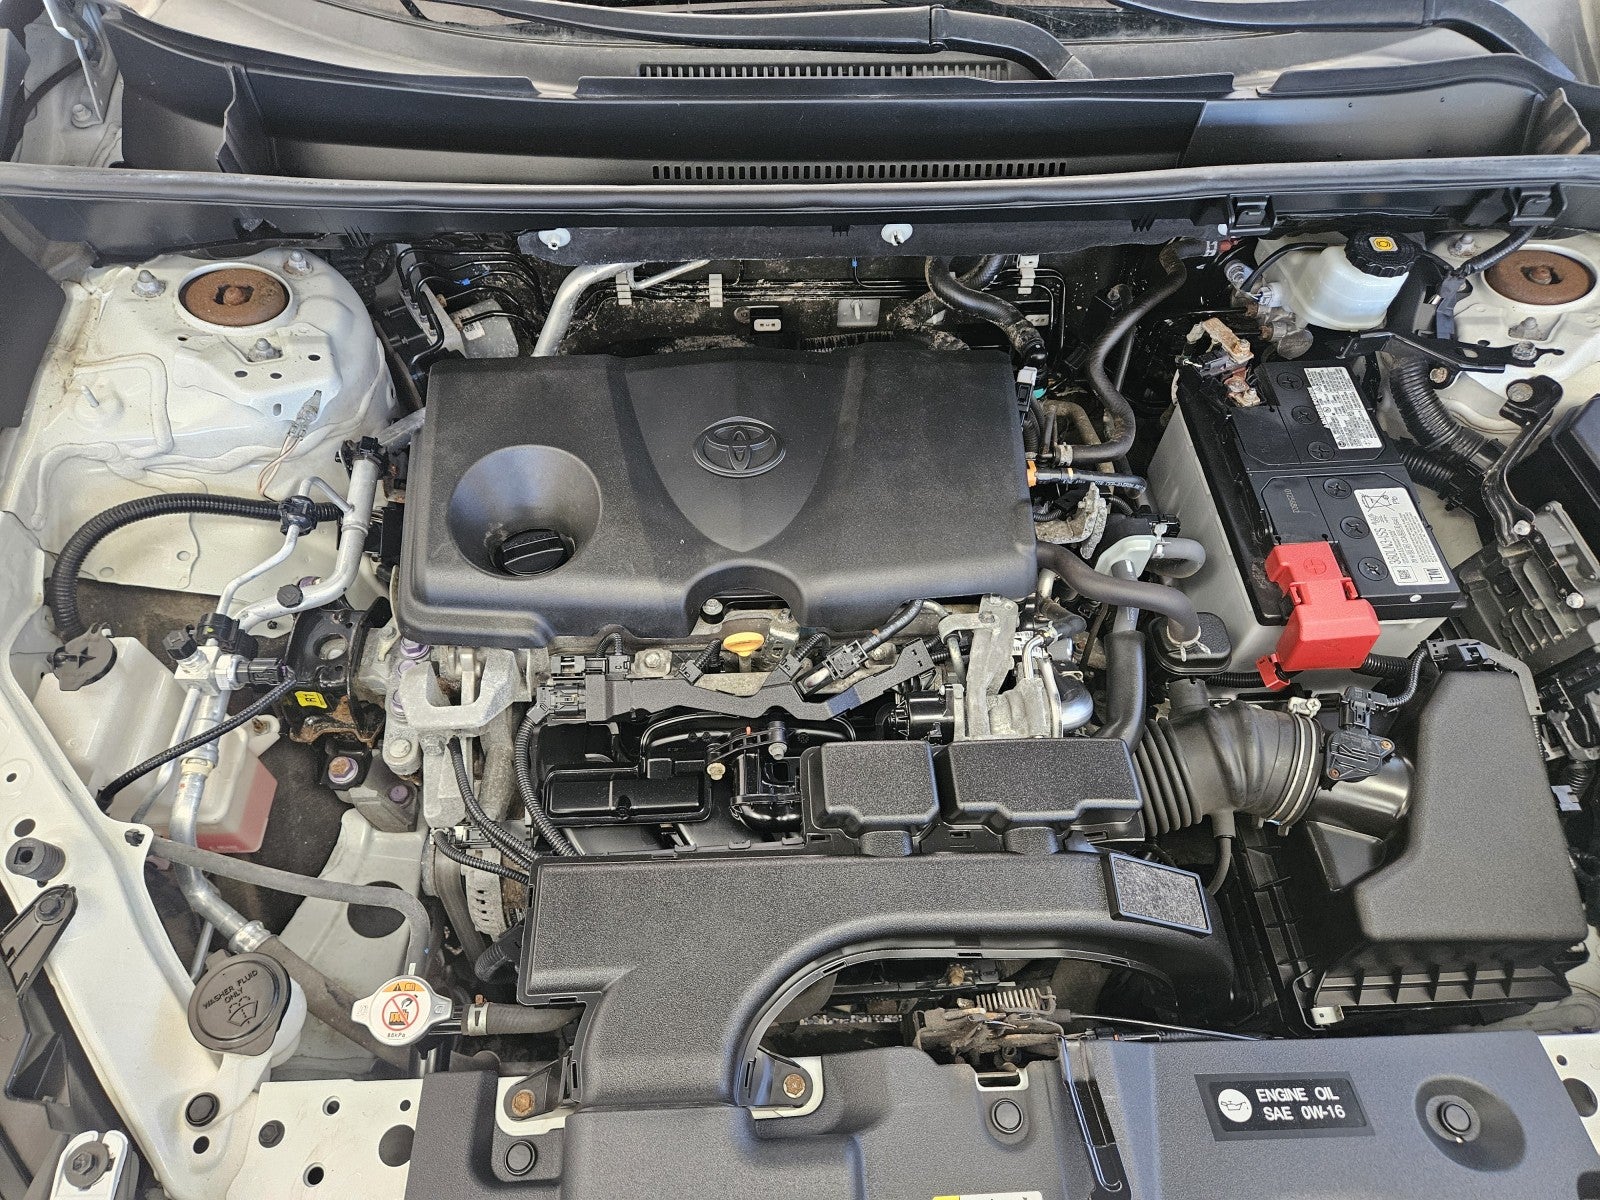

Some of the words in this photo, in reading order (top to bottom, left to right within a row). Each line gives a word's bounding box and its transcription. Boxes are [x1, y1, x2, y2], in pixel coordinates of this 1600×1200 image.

[203, 985, 235, 1009] WASHER
[237, 970, 258, 986] FLUID
[225, 987, 243, 1004] ONLY
[1256, 1087, 1308, 1103] ENGINE
[1314, 1086, 1340, 1101] OIL
[1263, 1106, 1294, 1121] SAE
[1301, 1104, 1346, 1120] 0W-16
